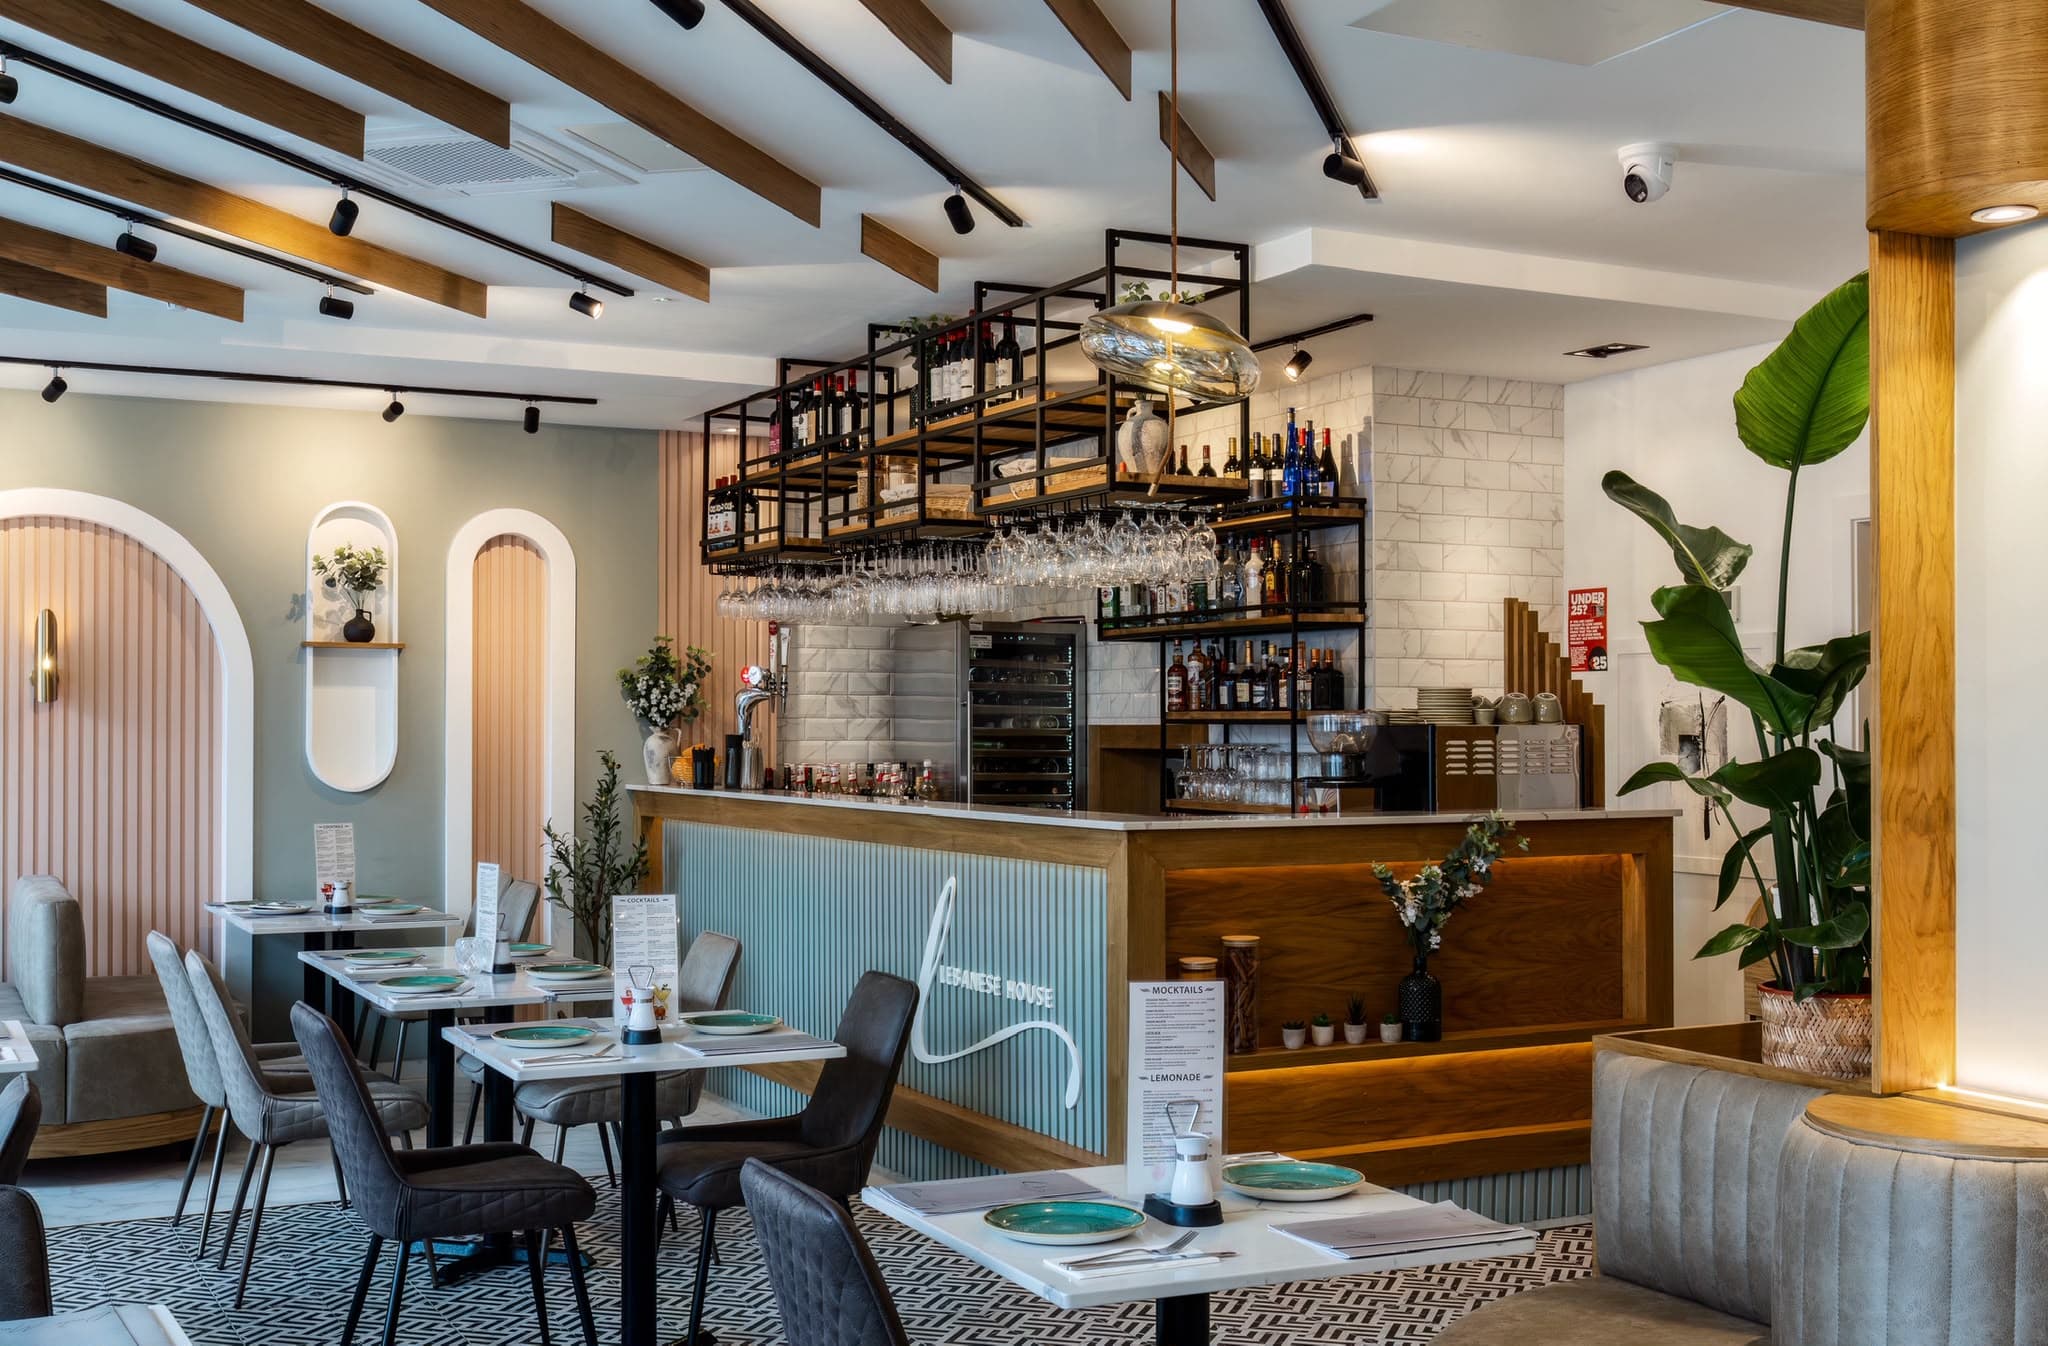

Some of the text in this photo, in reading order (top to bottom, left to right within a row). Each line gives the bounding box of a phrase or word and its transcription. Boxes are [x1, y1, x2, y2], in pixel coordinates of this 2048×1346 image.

[1571, 592, 1605, 605] UNDER
[1571, 605, 1588, 616] 25?
[1593, 656, 1607, 669] 25
[939, 965, 1055, 1009] LEBANESE HOUSE
[1152, 985, 1204, 995] MOCKTAILS
[1150, 1073, 1201, 1082] LEMONADE
